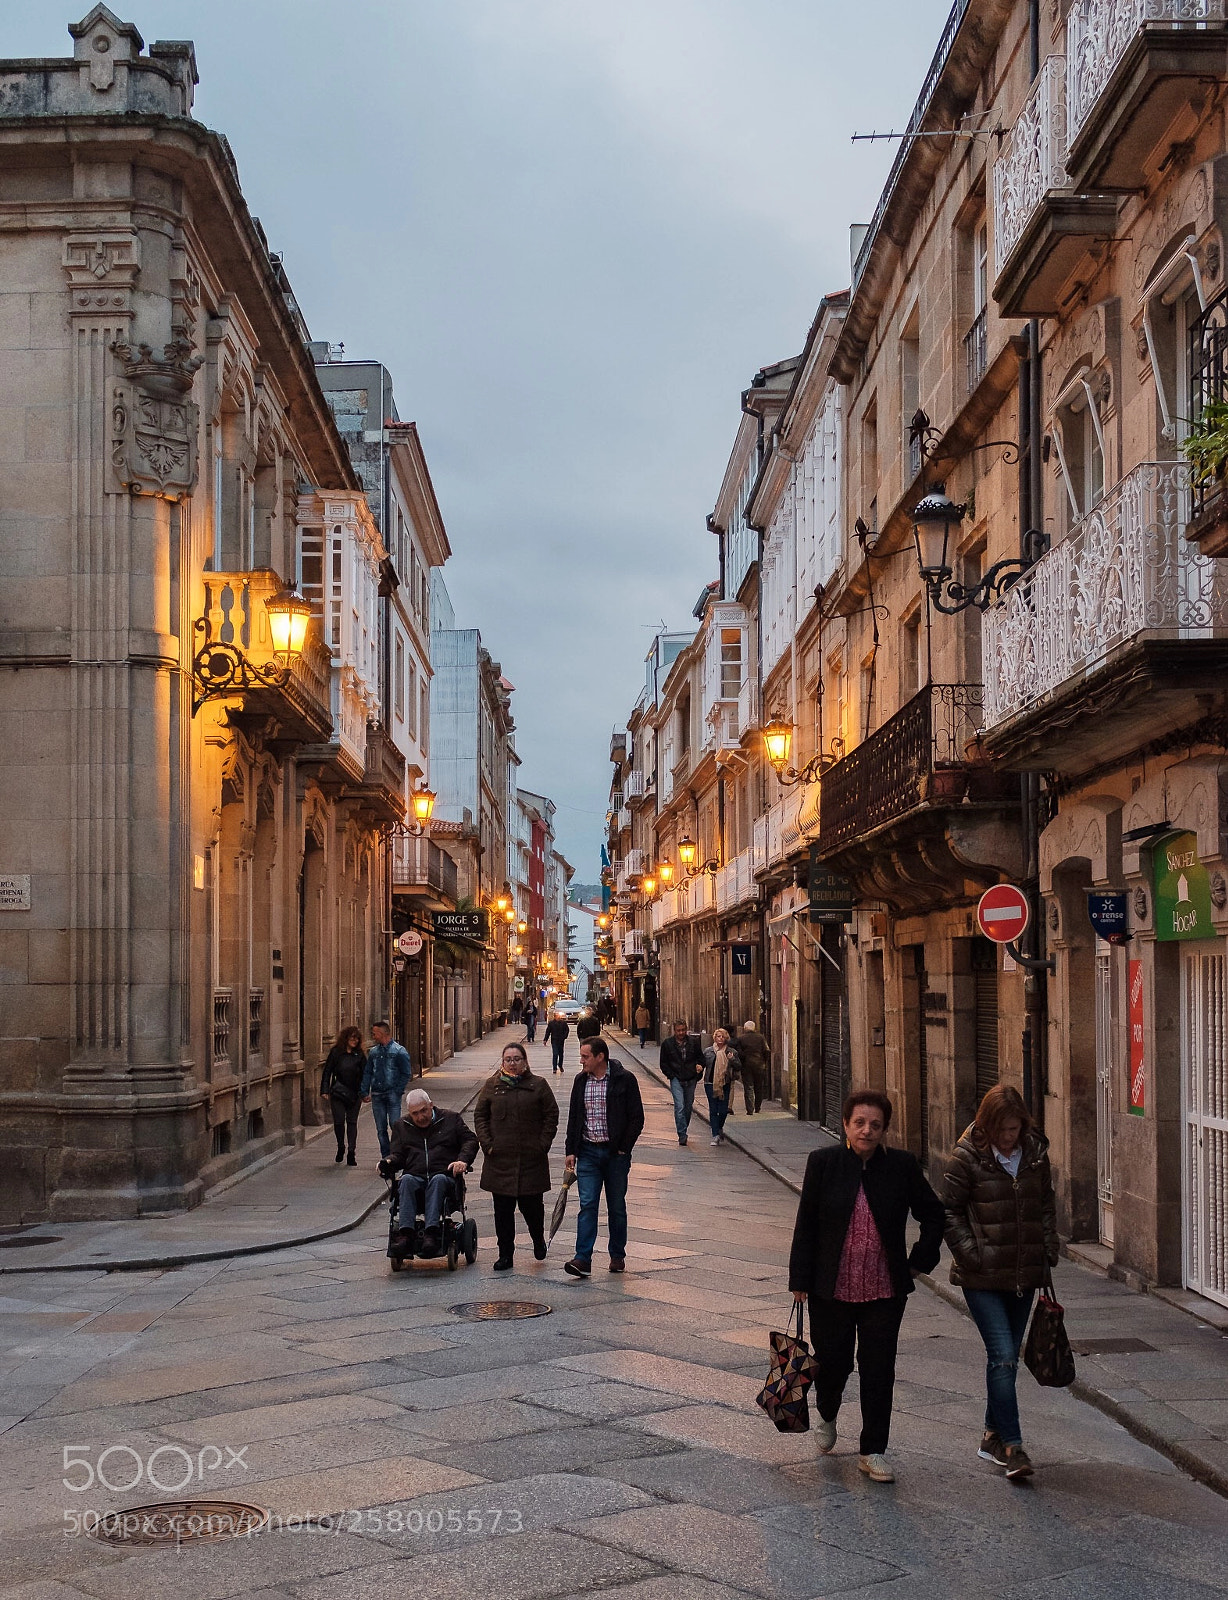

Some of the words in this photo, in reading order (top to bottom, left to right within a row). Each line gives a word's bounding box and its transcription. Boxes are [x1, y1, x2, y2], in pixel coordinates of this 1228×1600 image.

[437, 916, 467, 924] JORGE
[473, 916, 479, 924] 3
[1173, 909, 1197, 932] HOGAR
